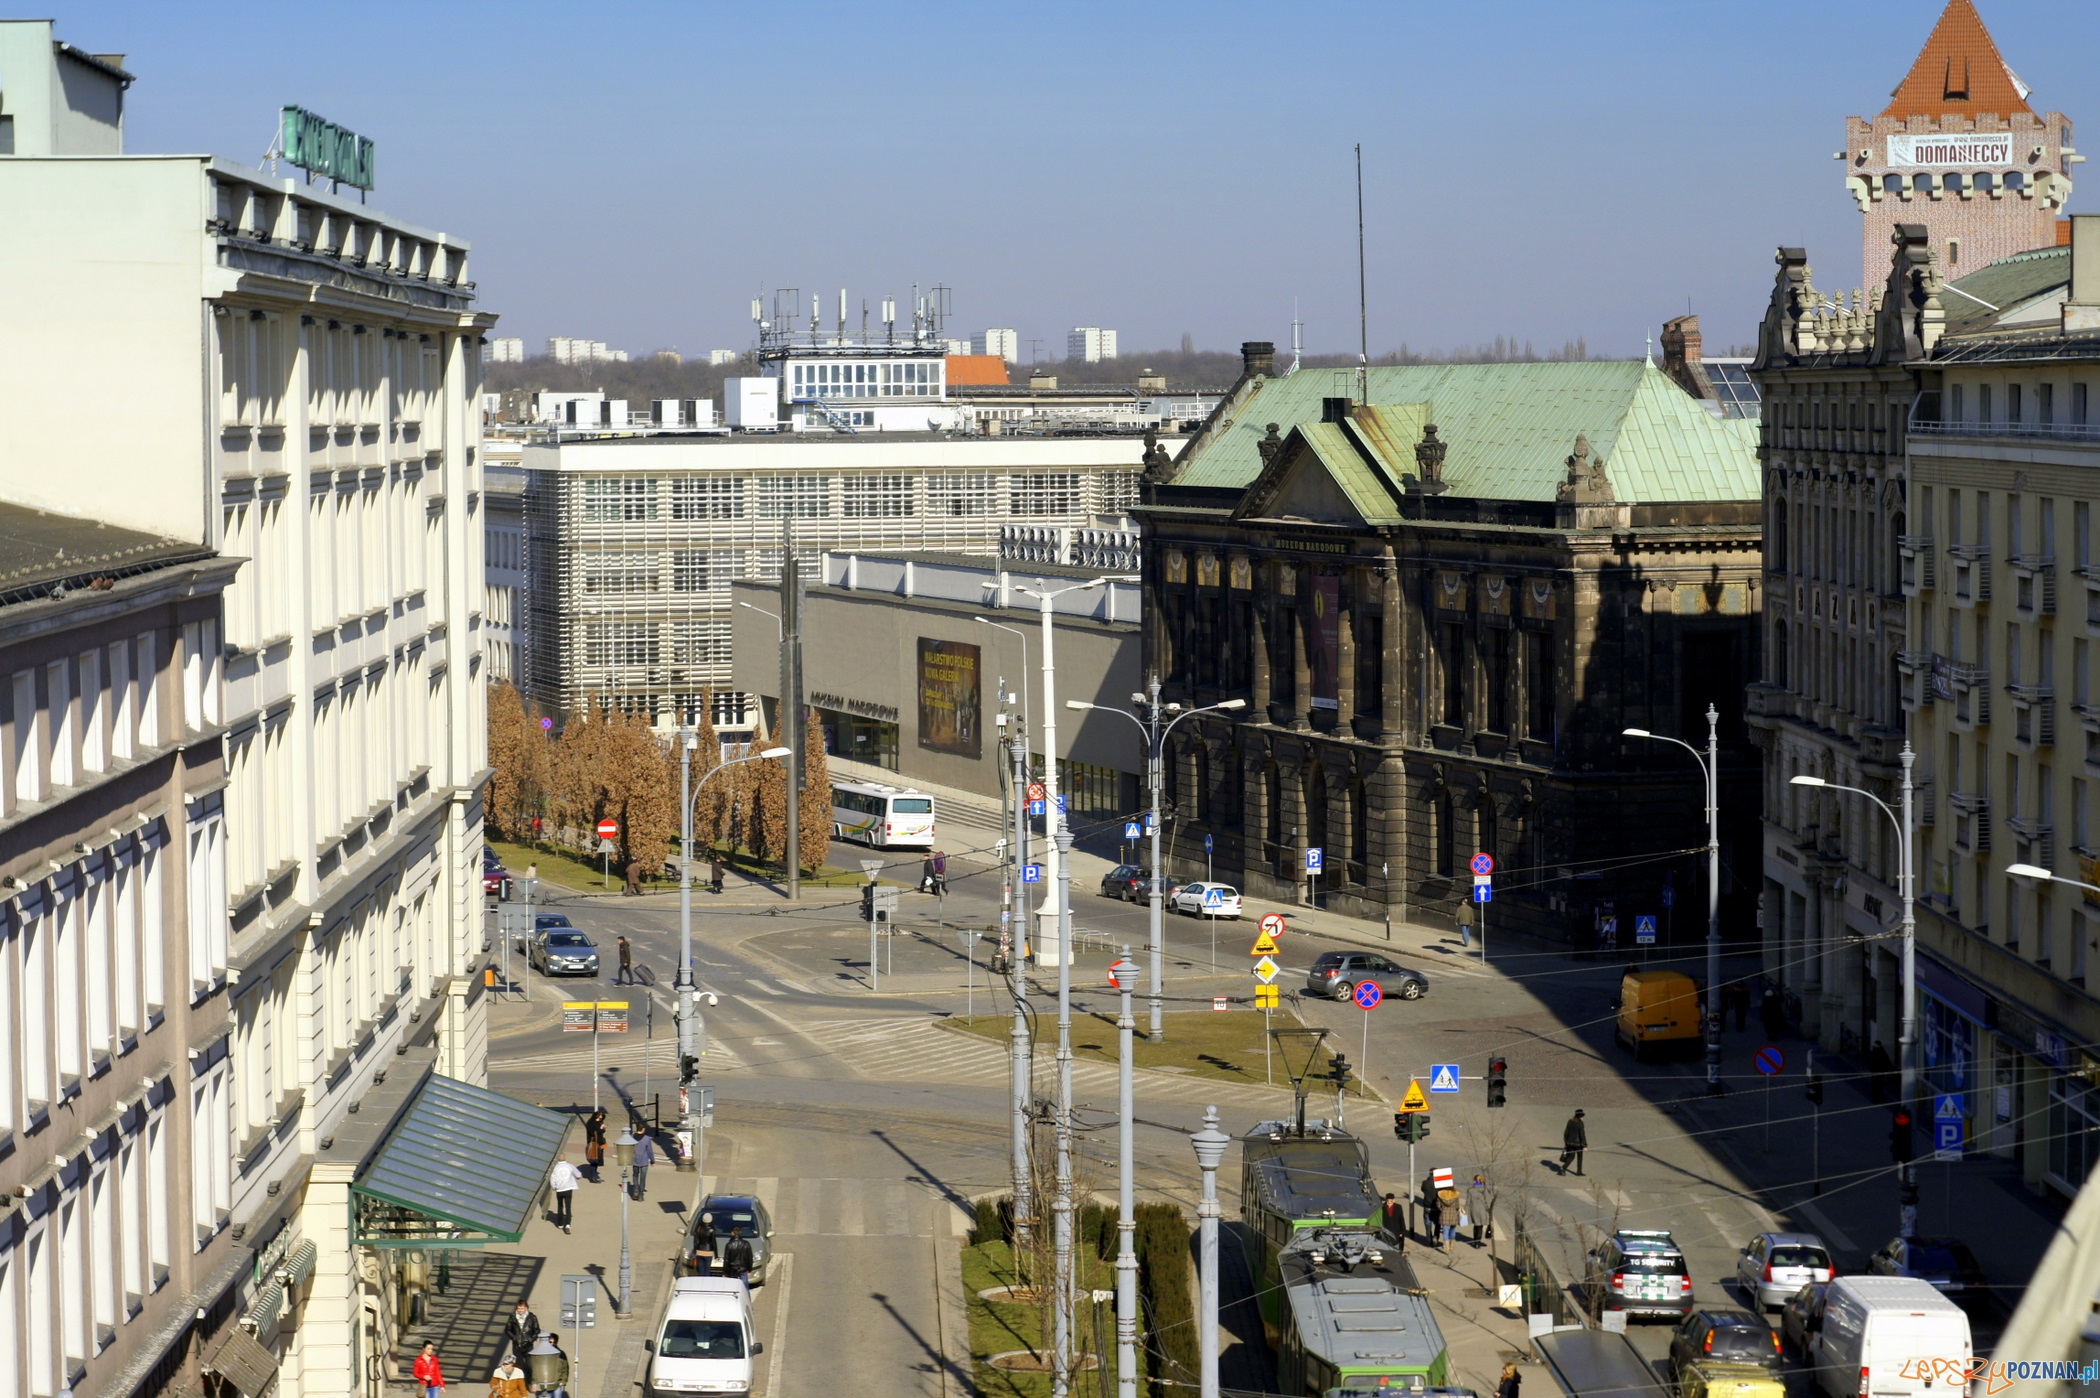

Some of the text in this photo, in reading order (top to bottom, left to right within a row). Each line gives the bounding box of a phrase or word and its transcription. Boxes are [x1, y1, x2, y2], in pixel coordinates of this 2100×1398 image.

[1915, 144, 2008, 163] DOMANIECCY
[1306, 542, 1346, 553] NARODOWE
[1799, 587, 1875, 630] BAZAR
[848, 698, 899, 716] NARODOWE
[1310, 853, 1319, 866] P
[1026, 867, 1036, 880] P
[1941, 1125, 1958, 1147] P
[392, 1249, 468, 1264] HOTEL
[1641, 1259, 1675, 1267] SECURITY
